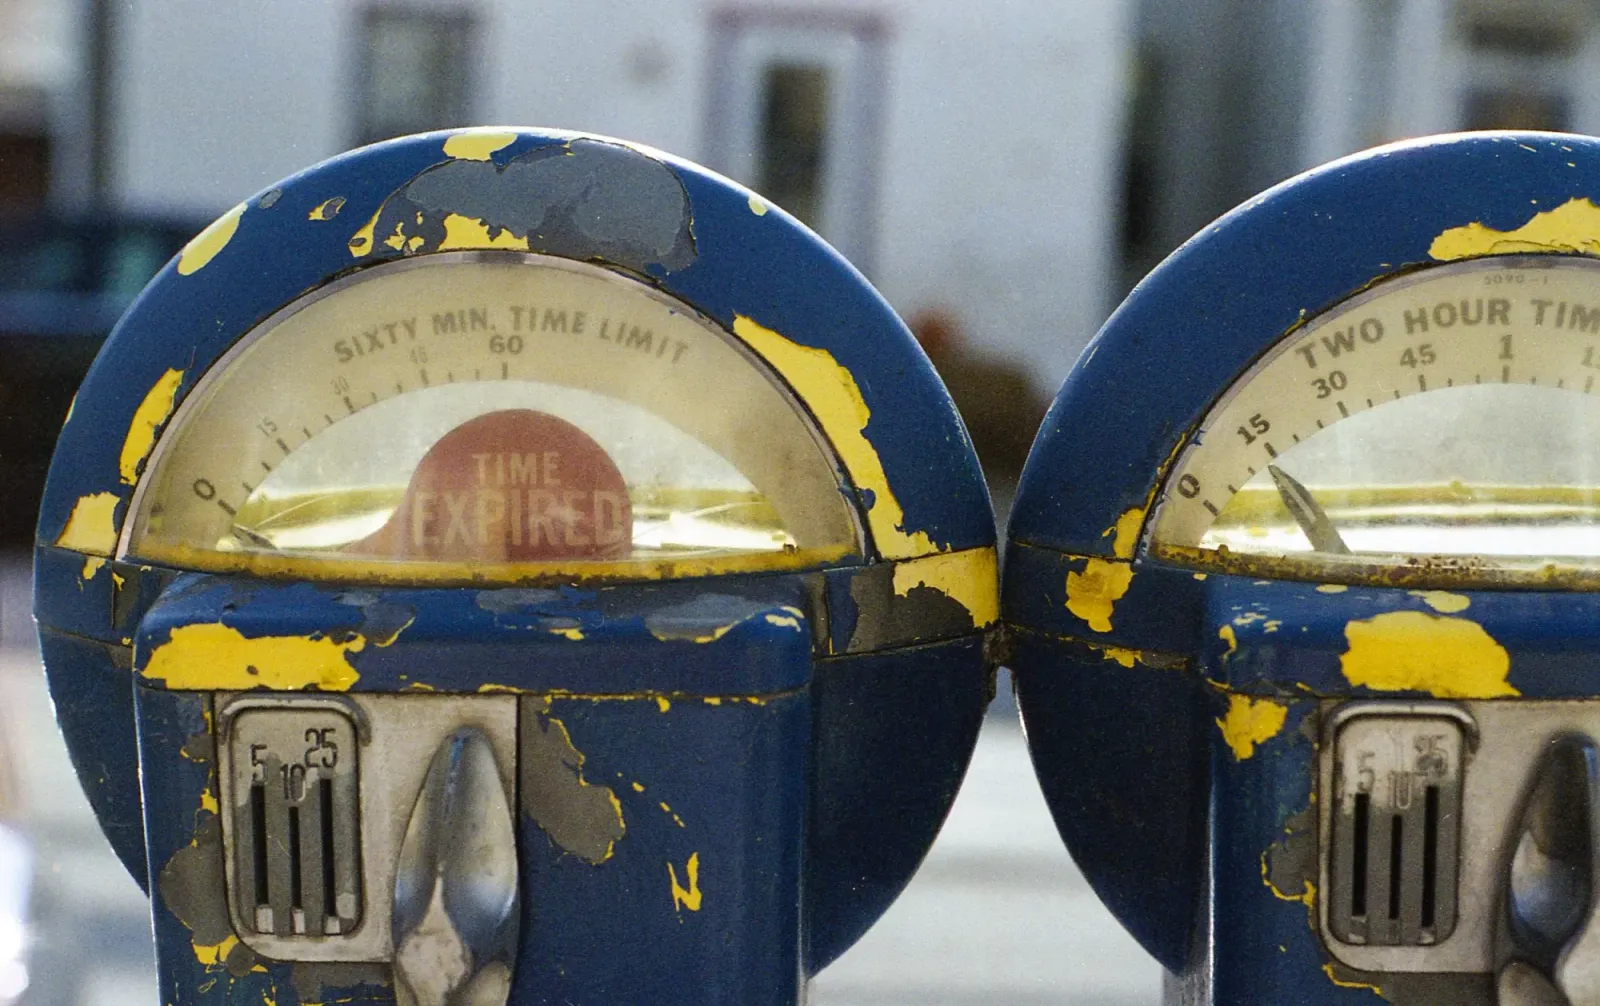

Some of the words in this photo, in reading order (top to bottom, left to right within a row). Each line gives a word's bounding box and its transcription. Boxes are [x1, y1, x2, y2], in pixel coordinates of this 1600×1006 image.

[333, 318, 418, 363] SIXTY
[432, 307, 496, 335] MIN.
[510, 306, 588, 335] TIME
[599, 319, 690, 364] LIMIT
[489, 335, 524, 355] 60
[1295, 317, 1384, 369] TWO
[1404, 298, 1511, 335] HOUR
[1498, 334, 1514, 360] 1
[1400, 343, 1437, 368] 45
[330, 375, 349, 395] 30
[1310, 370, 1348, 399] 30
[256, 416, 278, 438] 15
[1237, 413, 1270, 446] 15
[472, 452, 560, 485] TIME
[193, 478, 216, 500] 0
[1176, 473, 1200, 499] 0
[413, 489, 624, 547] EXPIRED
[250, 743, 268, 783] 5
[304, 728, 338, 768] 25
[280, 763, 306, 801] 10
[1357, 750, 1375, 793] 5
